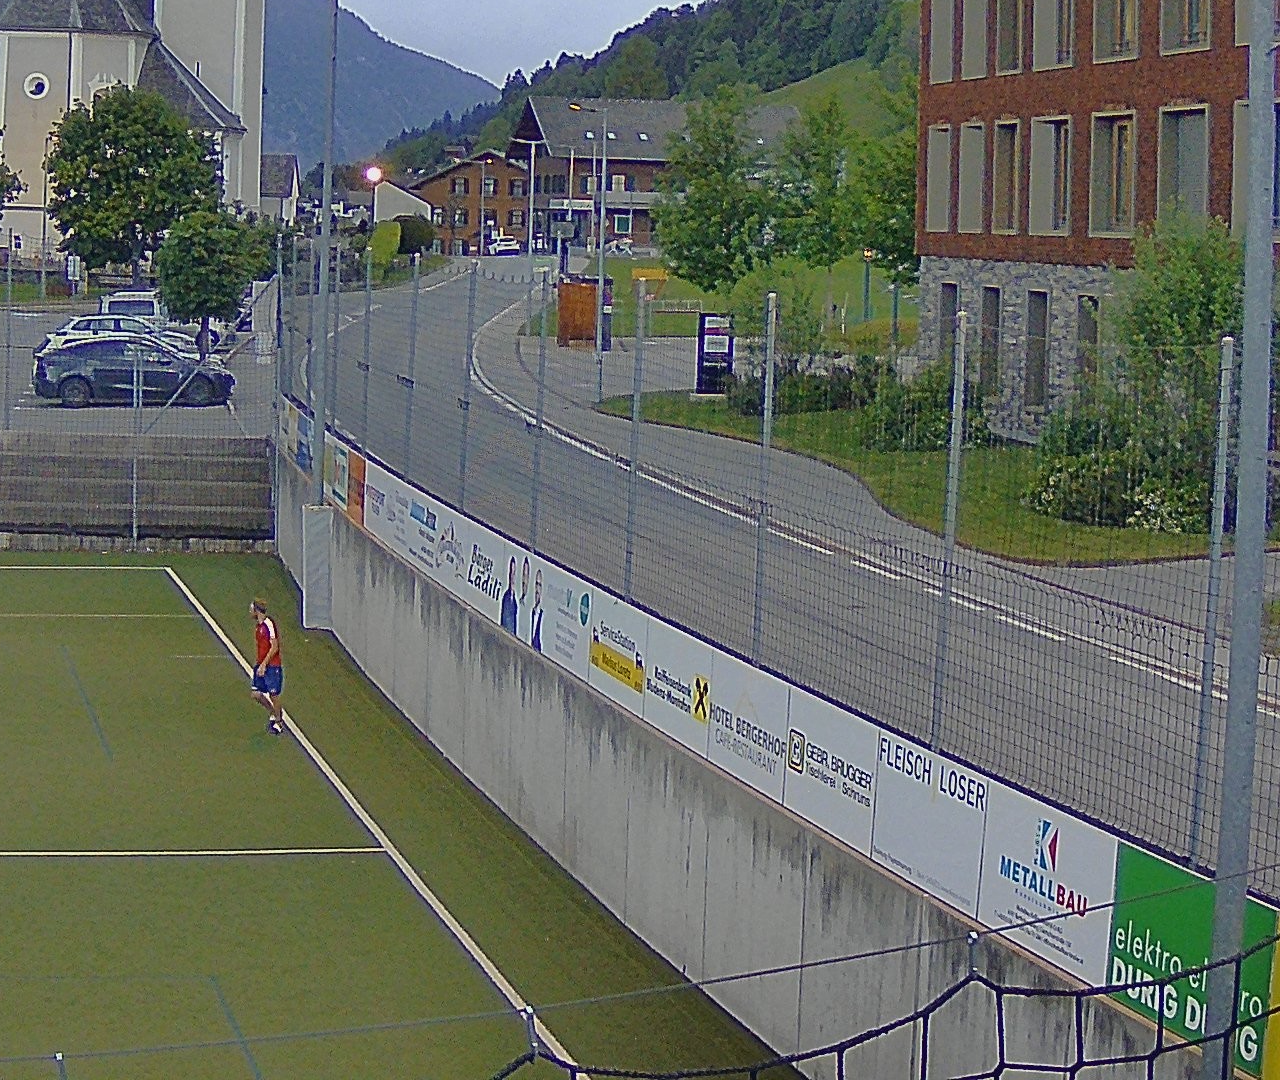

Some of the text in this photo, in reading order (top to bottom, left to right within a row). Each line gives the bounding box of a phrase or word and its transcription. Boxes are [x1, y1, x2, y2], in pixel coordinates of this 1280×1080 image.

[709, 702, 787, 759] HOTEL BERGERHOF
[805, 742, 830, 769] GEBR.
[879, 737, 933, 786] FLEISCH
[999, 855, 1088, 918] METALLBAU
[1115, 920, 1182, 975] elektro
